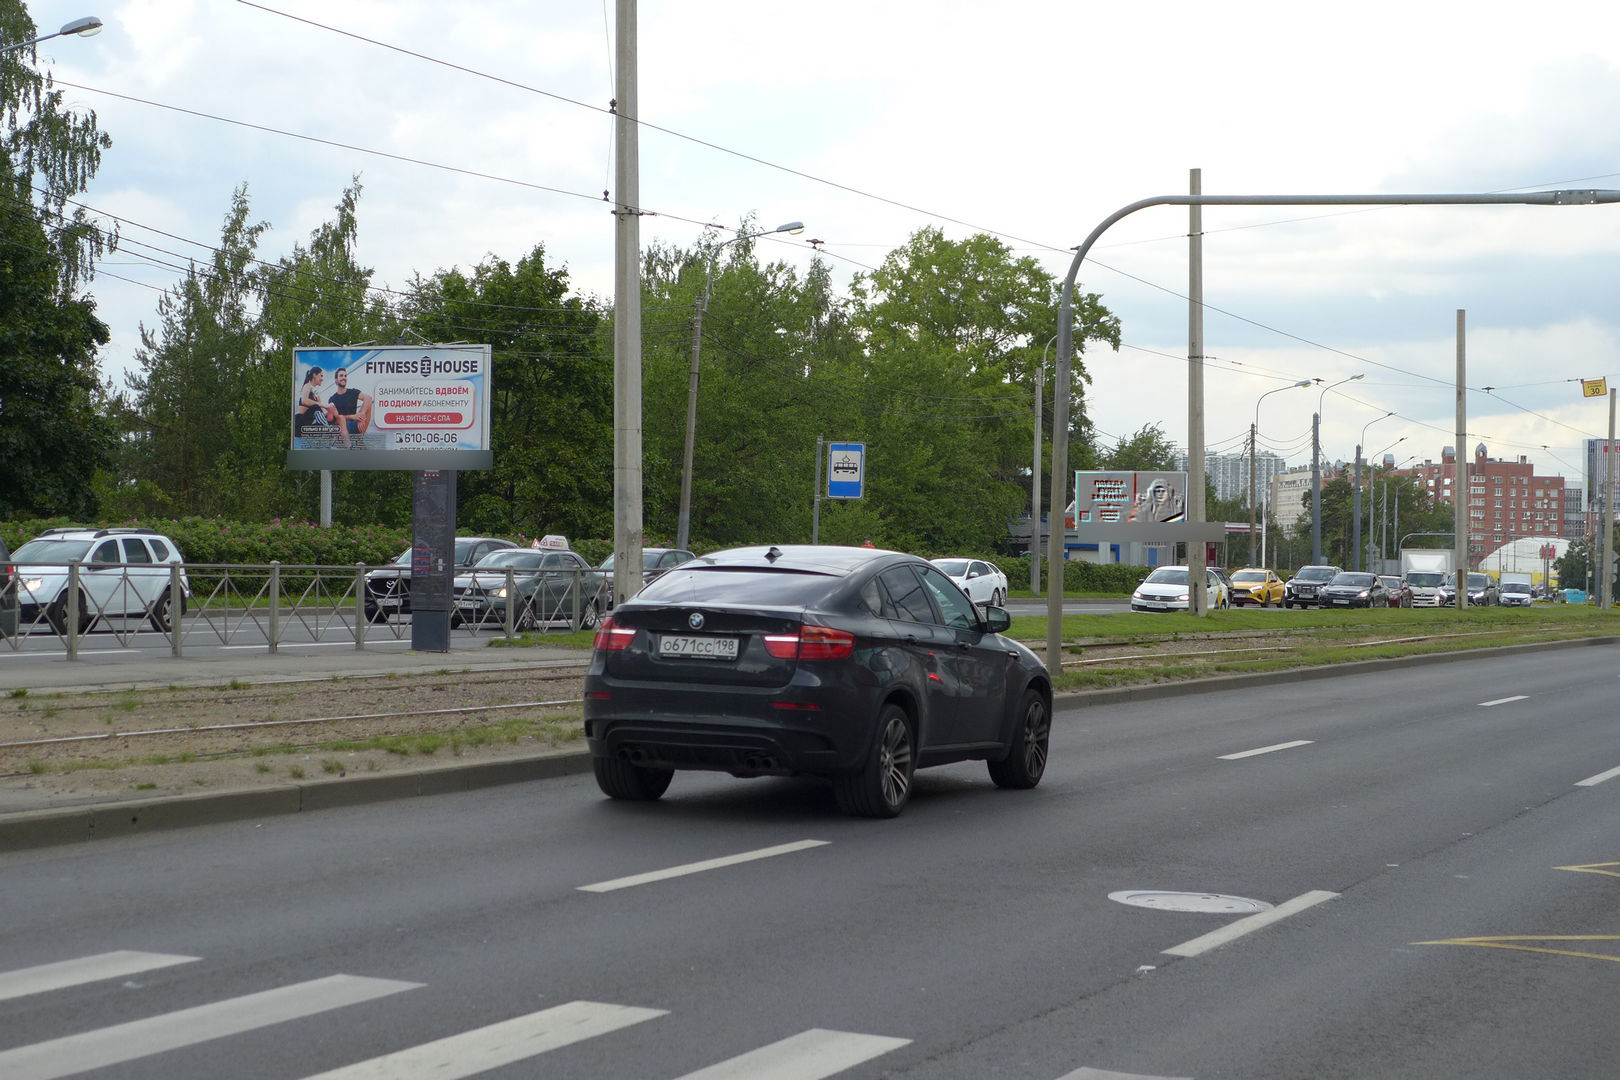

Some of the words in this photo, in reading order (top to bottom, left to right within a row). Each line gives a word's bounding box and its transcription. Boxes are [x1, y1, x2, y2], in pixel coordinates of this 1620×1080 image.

[366, 361, 418, 374] FITNESS
[433, 360, 478, 373] HOUSE
[378, 387, 434, 396] ЗАНИМАЙТЕСЬ
[435, 386, 469, 397] ВДВОЁМ
[390, 400, 422, 408] ОДНОМУ
[422, 399, 470, 408] АБОНЕМЕНТУ
[406, 415, 432, 423] ФИТНЕС
[404, 433, 458, 443] 610-06-06
[715, 640, 735, 651] 198
